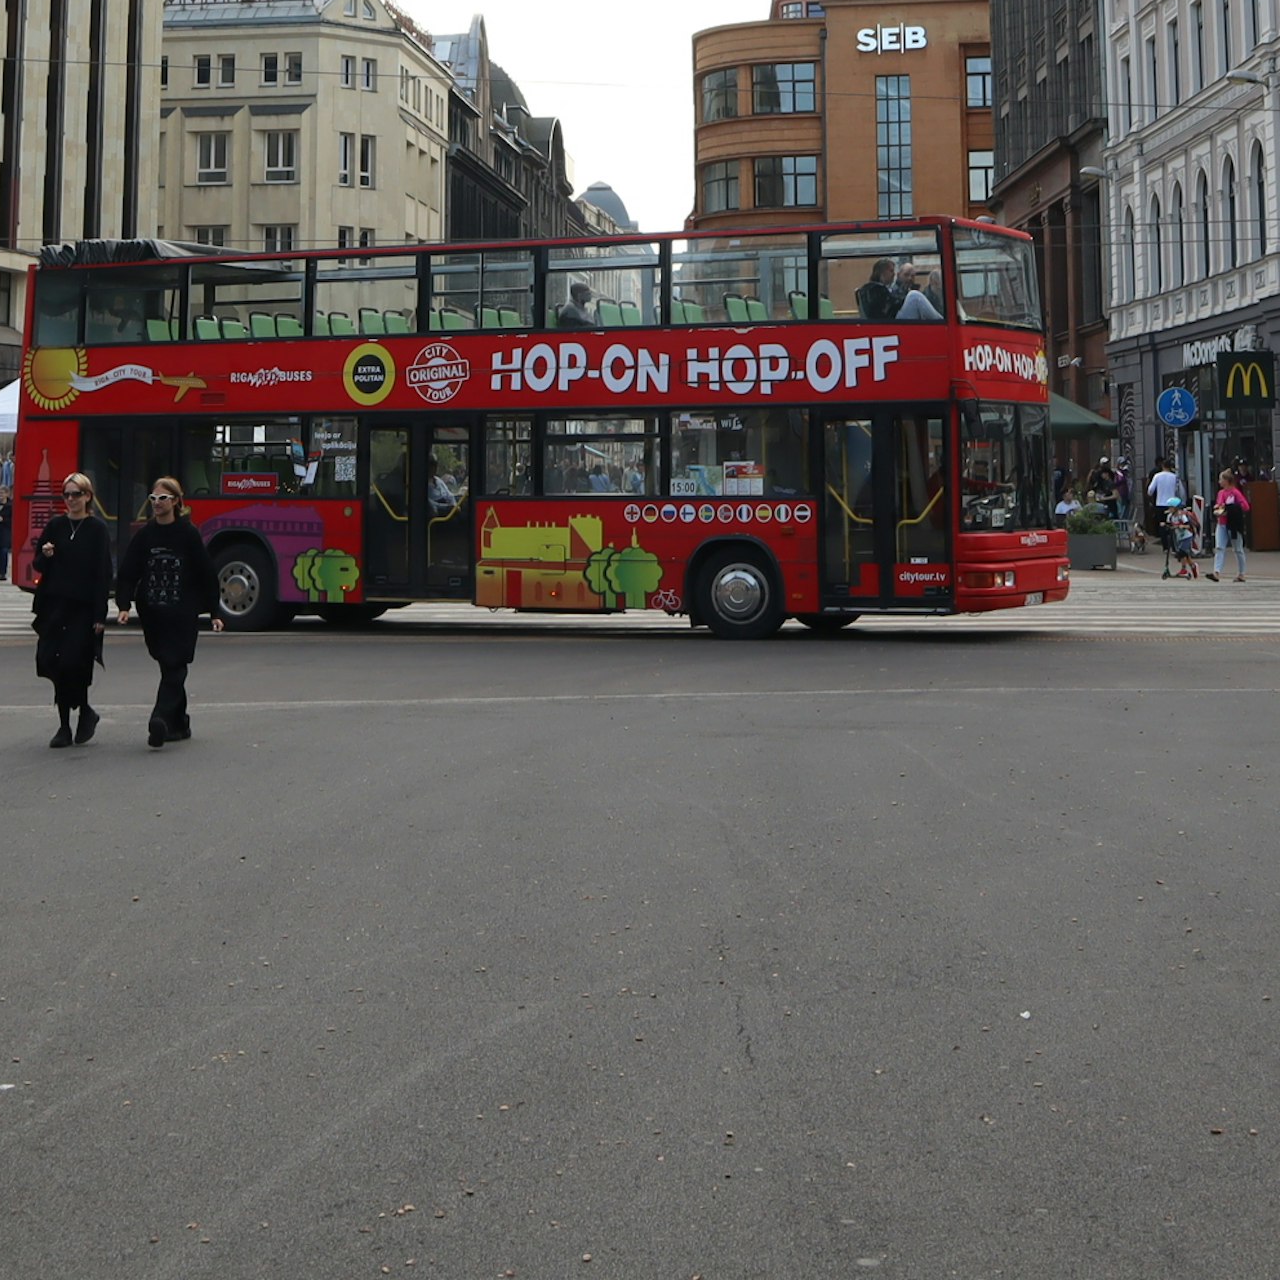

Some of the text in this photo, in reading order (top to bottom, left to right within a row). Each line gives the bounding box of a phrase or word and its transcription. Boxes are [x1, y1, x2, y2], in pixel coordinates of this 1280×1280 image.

[856, 23, 928, 55] SEB
[424, 346, 449, 359] CITY
[963, 344, 1013, 373] HOP-ON
[358, 365, 381, 374] EXTRA
[490, 335, 900, 395] HOP-ON HOP-OFF
[113, 368, 126, 379] CITY
[129, 367, 147, 379] TOUR
[279, 370, 313, 382] BUSES
[354, 374, 384, 383] POLITAN
[410, 364, 465, 382] ORIGINAL
[426, 387, 453, 400] TOUR
[671, 482, 695, 493] 15:00
[899, 571, 946, 584] citytour.lv
